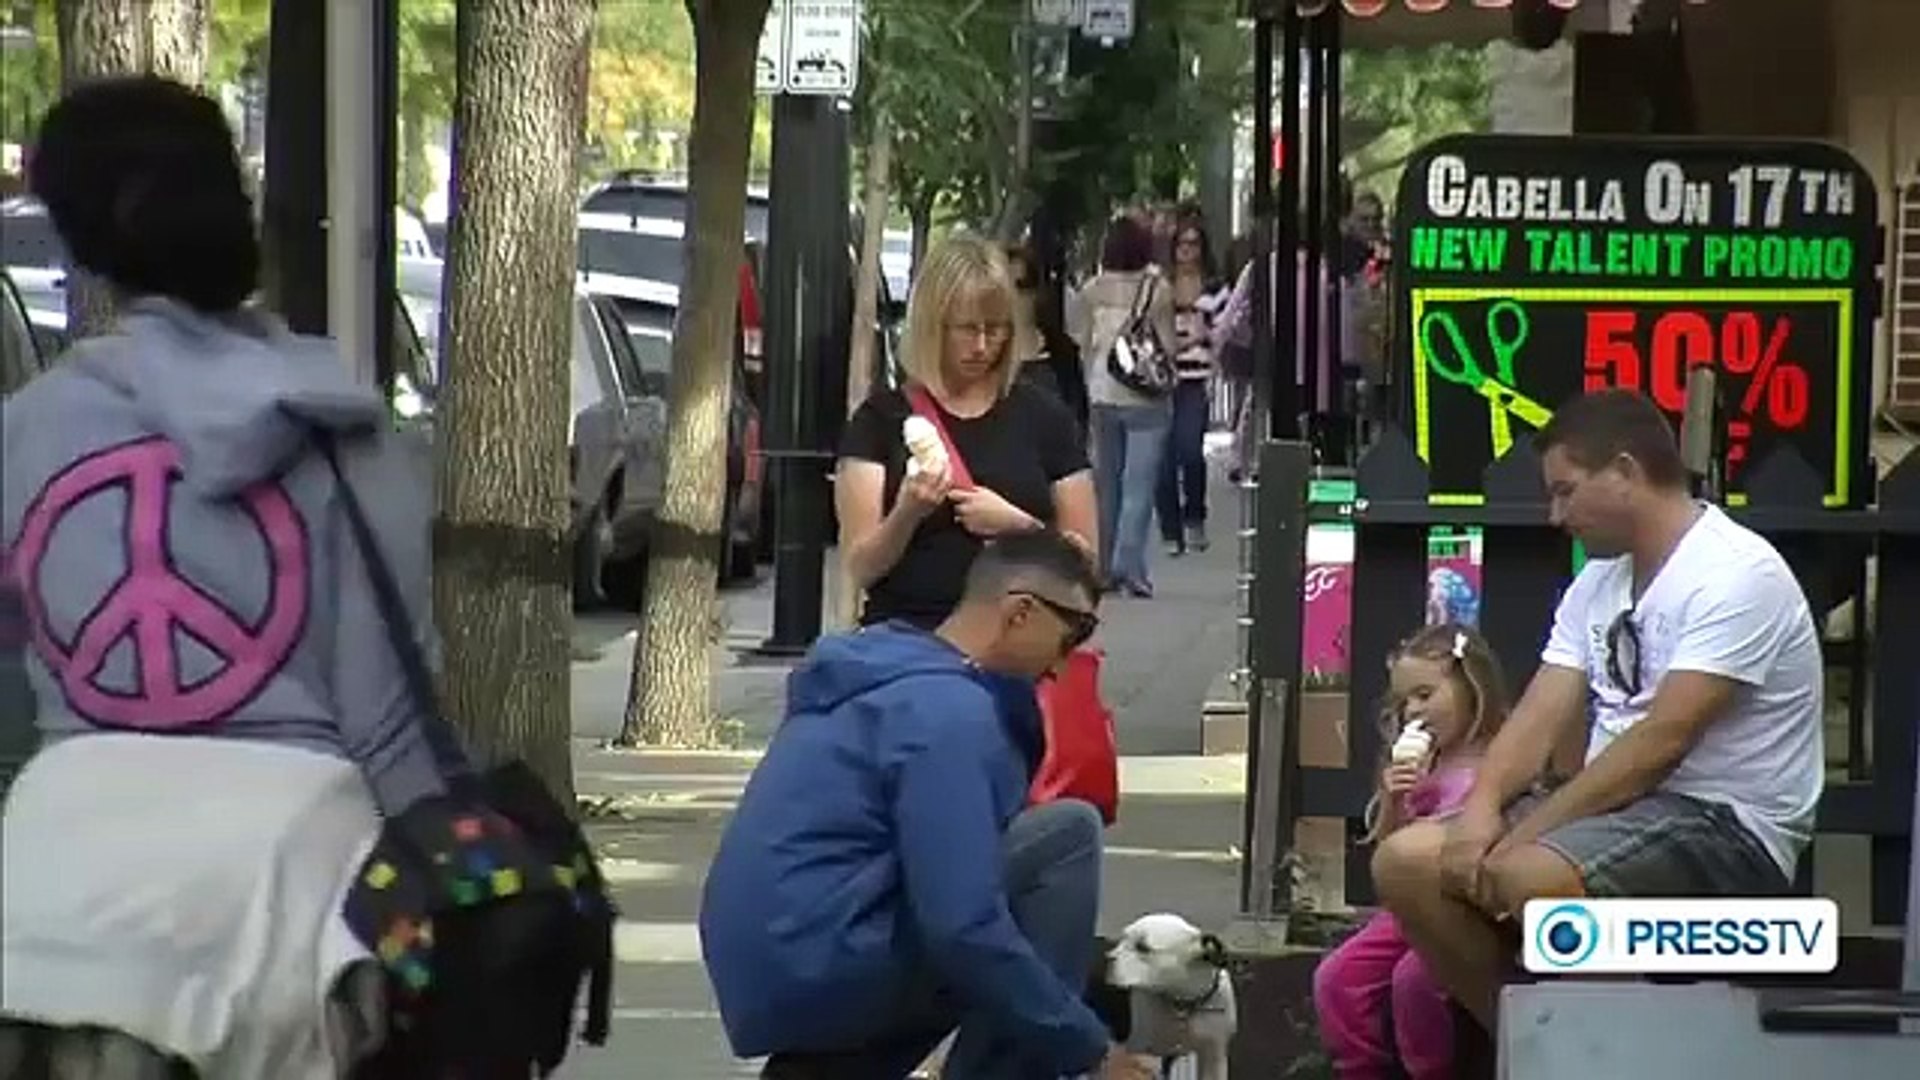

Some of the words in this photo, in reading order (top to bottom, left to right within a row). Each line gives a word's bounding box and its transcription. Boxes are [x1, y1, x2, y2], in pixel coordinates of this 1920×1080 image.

[1427, 154, 1626, 222] CABELLA
[1644, 160, 1709, 226] ON
[1728, 165, 1855, 228] 17TH
[1410, 227, 1507, 270] NEW
[1525, 231, 1690, 277] TALENT
[1704, 235, 1853, 279] PROMO
[1583, 311, 1809, 428] 50%
